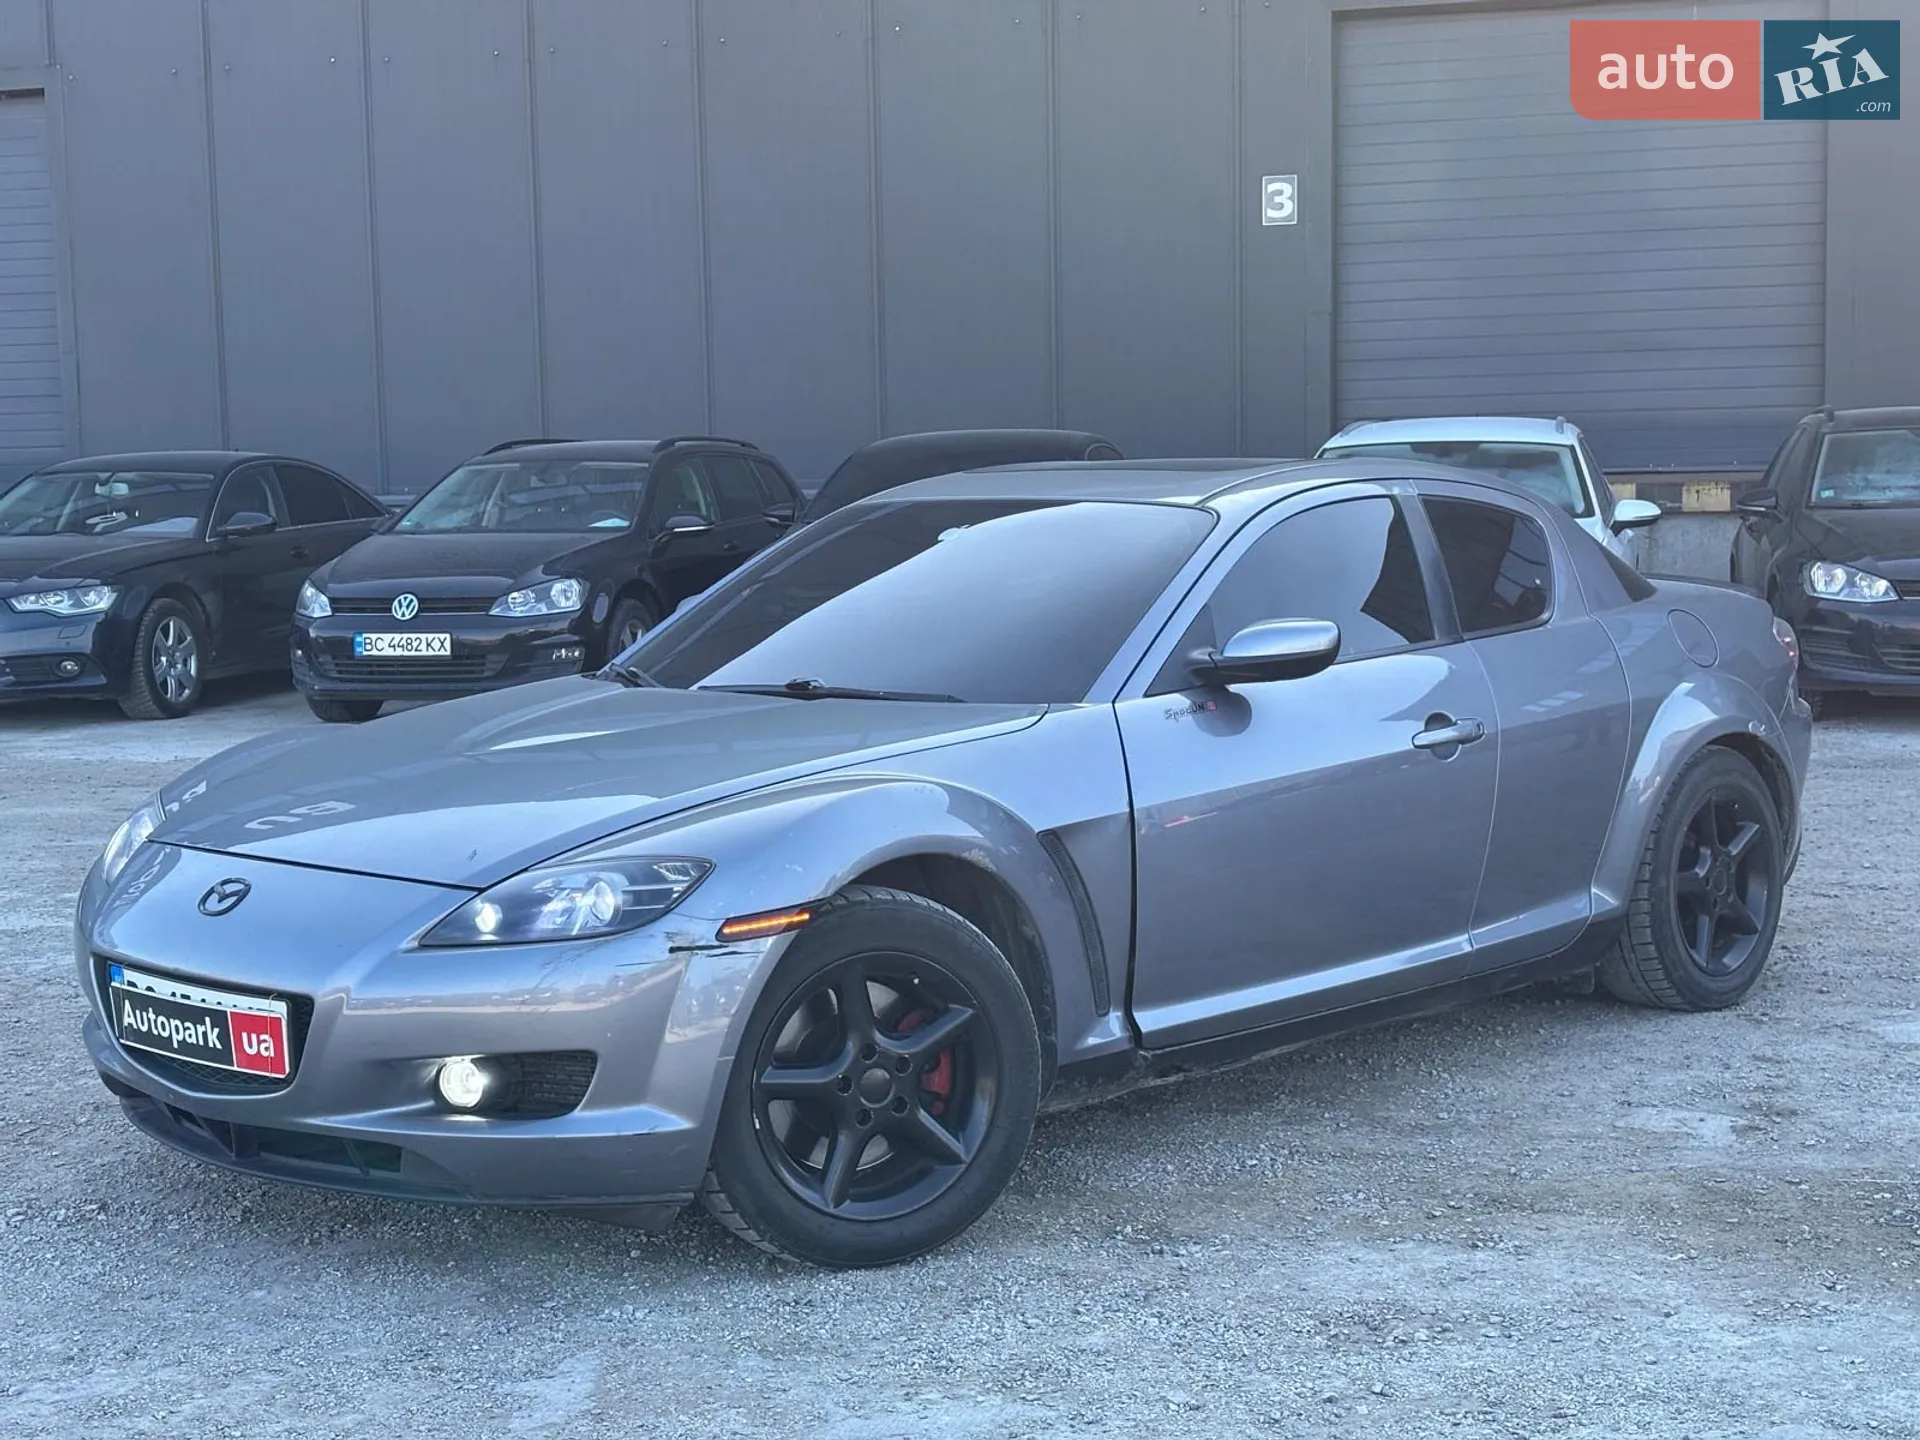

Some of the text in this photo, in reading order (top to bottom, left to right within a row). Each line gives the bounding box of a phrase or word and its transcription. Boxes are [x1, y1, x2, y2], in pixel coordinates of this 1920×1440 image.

[1266, 182, 1294, 218] 3
[363, 636, 385, 652] BC
[388, 636, 423, 652] 4482
[425, 636, 448, 652] KX
[123, 999, 275, 1058] Autopark ua
